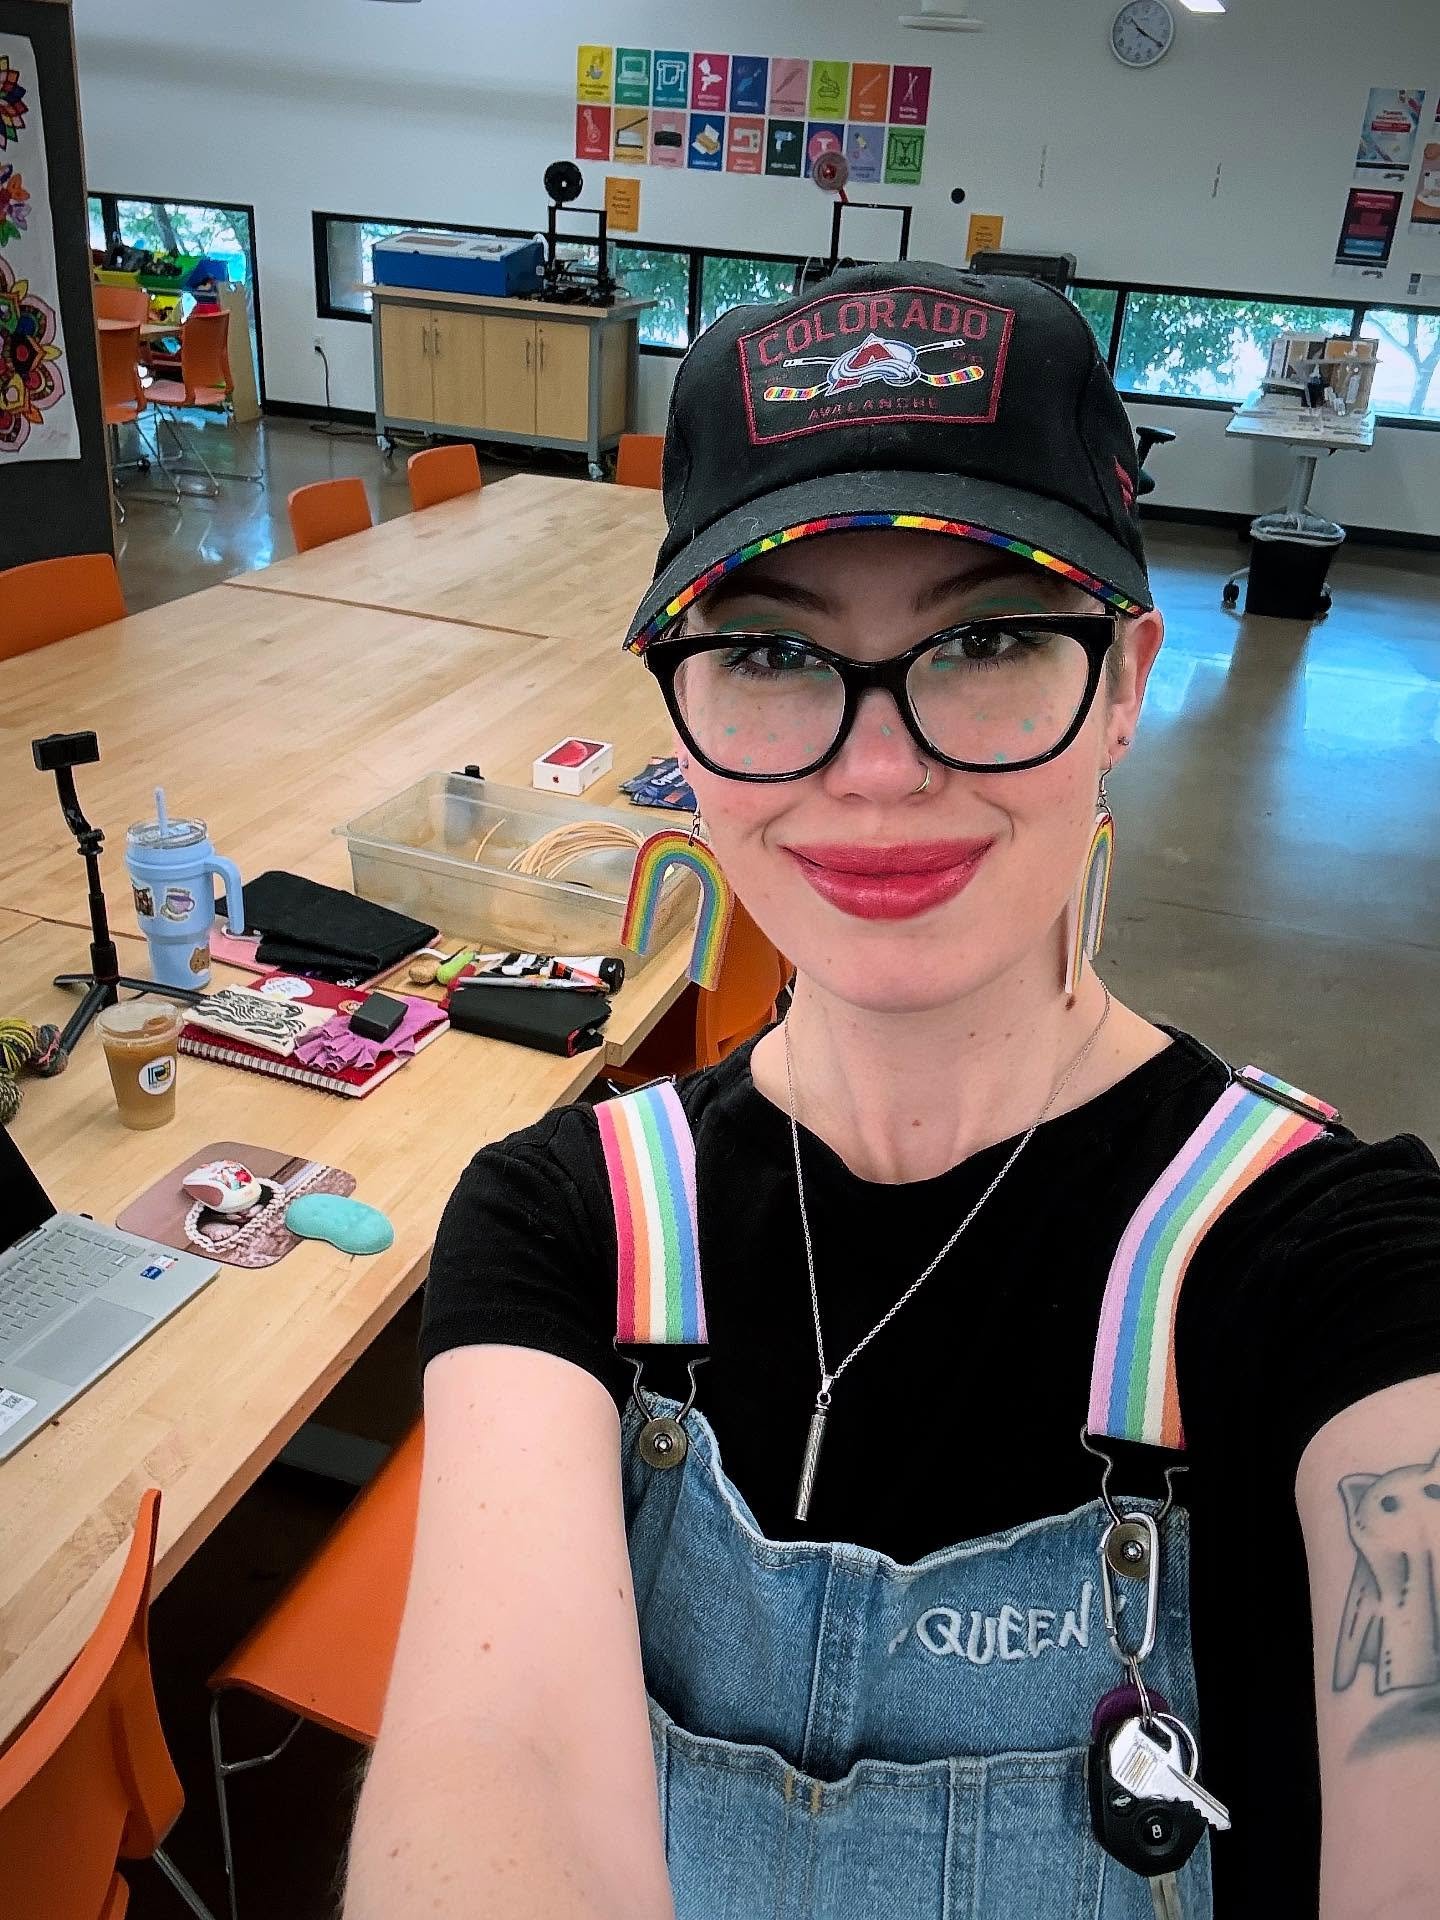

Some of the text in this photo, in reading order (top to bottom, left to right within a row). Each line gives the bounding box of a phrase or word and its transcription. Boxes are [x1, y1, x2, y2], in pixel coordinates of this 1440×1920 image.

[758, 298, 989, 366] COLORADO
[808, 396, 938, 421] AVALANCHE
[916, 1580, 1093, 1665] QUEEN
